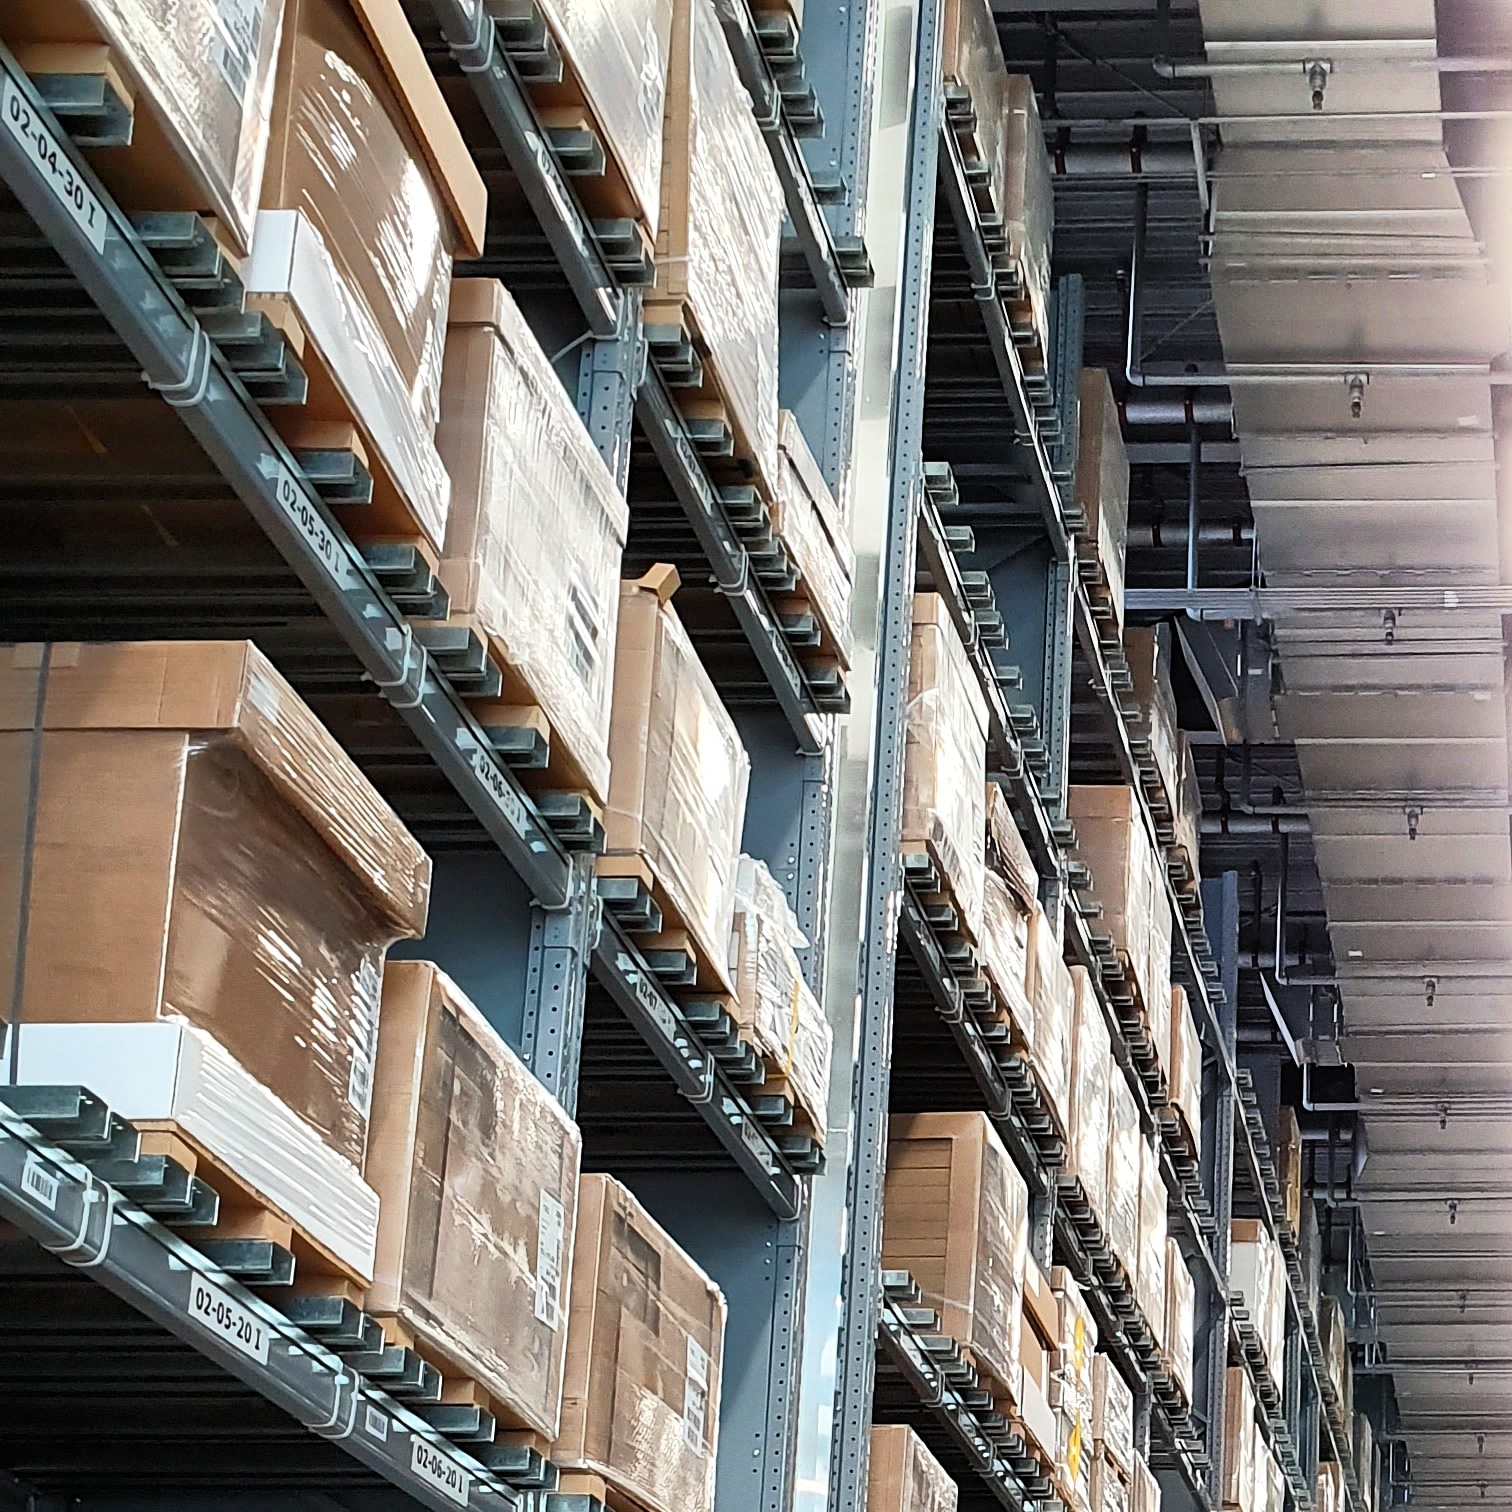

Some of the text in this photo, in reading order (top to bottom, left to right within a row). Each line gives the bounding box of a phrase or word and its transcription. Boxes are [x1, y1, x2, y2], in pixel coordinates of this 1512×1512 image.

[10, 95, 84, 210] 02-04-30
[283, 480, 332, 561] 02-05-30
[479, 755, 516, 816] 02-06-
[196, 1287, 252, 1344] 02-05-20
[417, 1445, 457, 1488] 02-06-20
